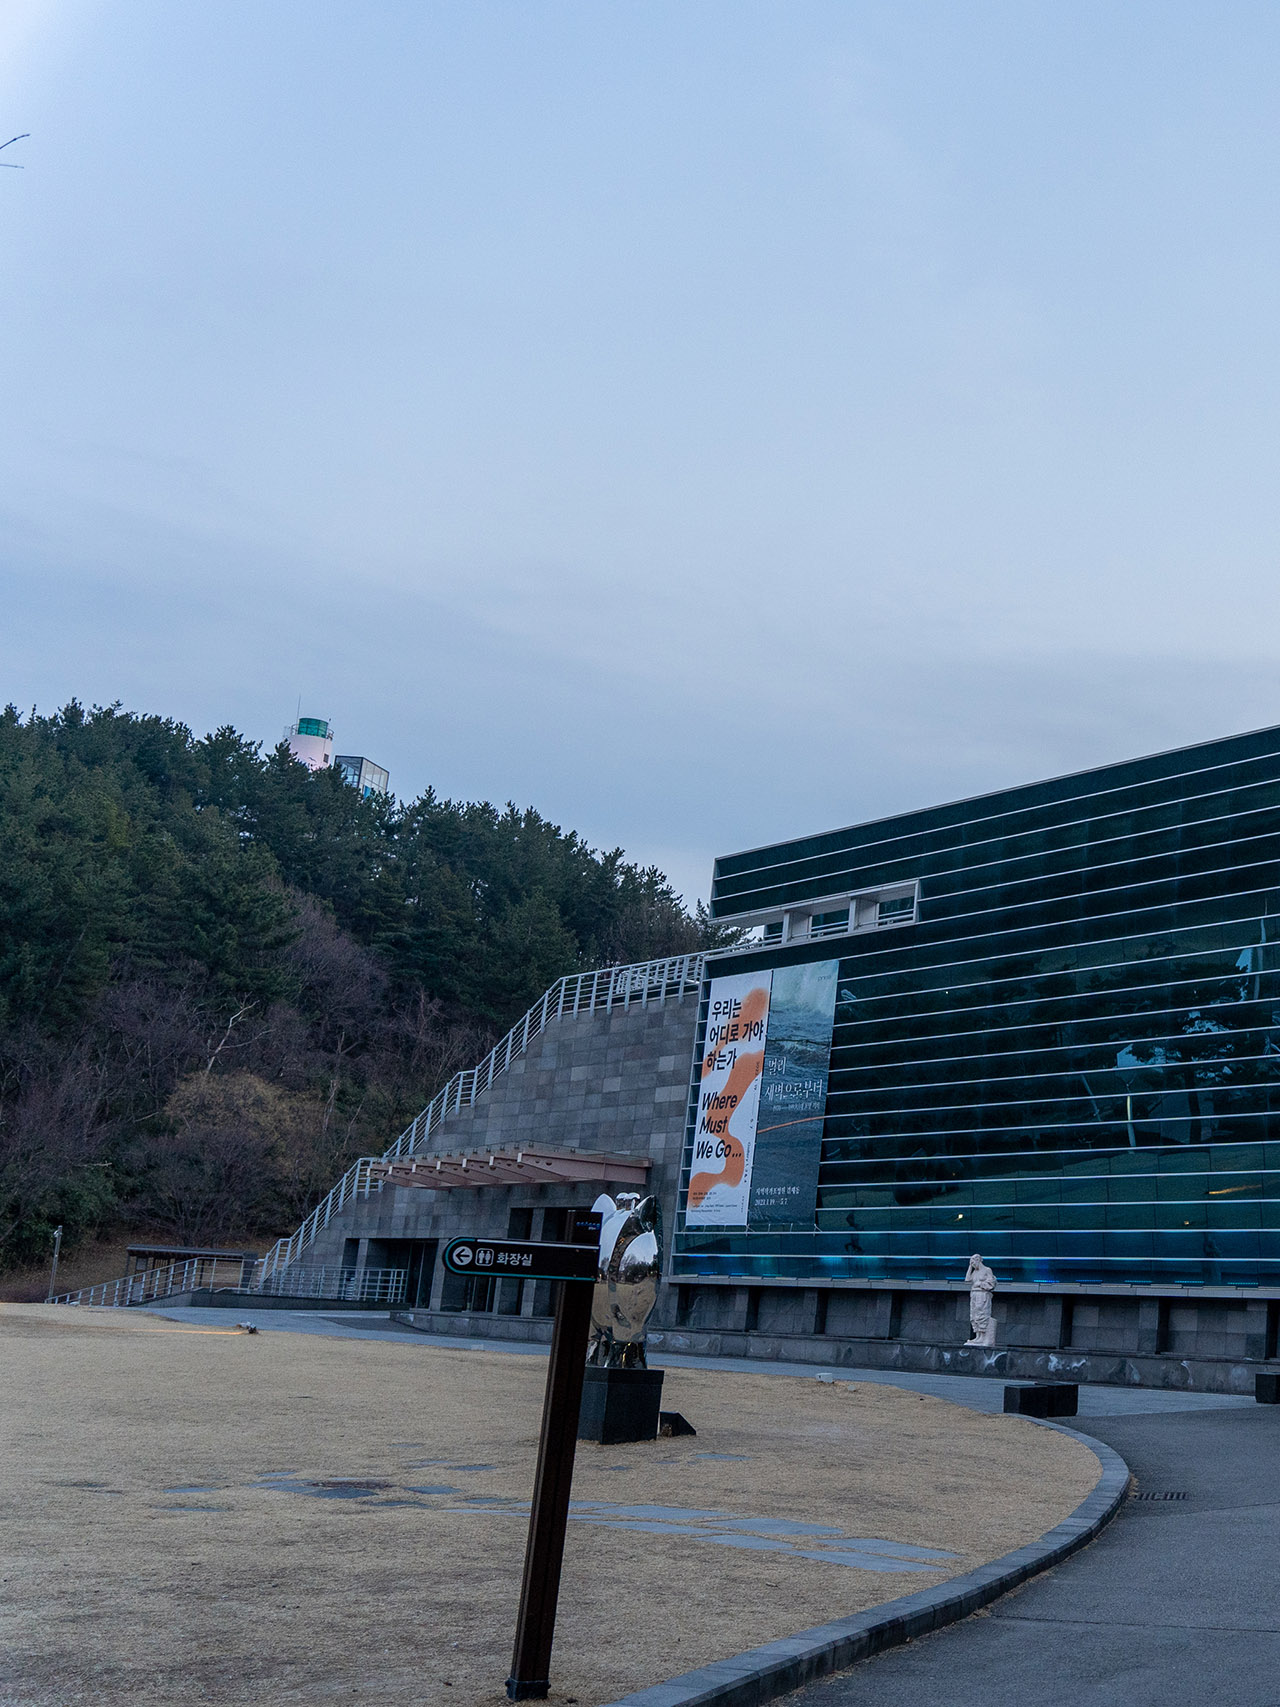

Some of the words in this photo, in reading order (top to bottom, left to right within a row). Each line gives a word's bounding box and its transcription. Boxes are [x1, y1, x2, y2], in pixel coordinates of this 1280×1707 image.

[712, 999, 742, 1021] 우리는
[710, 1023, 739, 1046] 어디로
[742, 1019, 764, 1041] 가야
[706, 1048, 737, 1071] 하는가
[769, 1056, 787, 1075] 멀리
[765, 1079, 823, 1101] 새벽으로부터
[702, 1091, 738, 1111] Where
[699, 1115, 728, 1135] Must
[696, 1140, 714, 1159] We
[496, 1252, 533, 1266] 화장실
